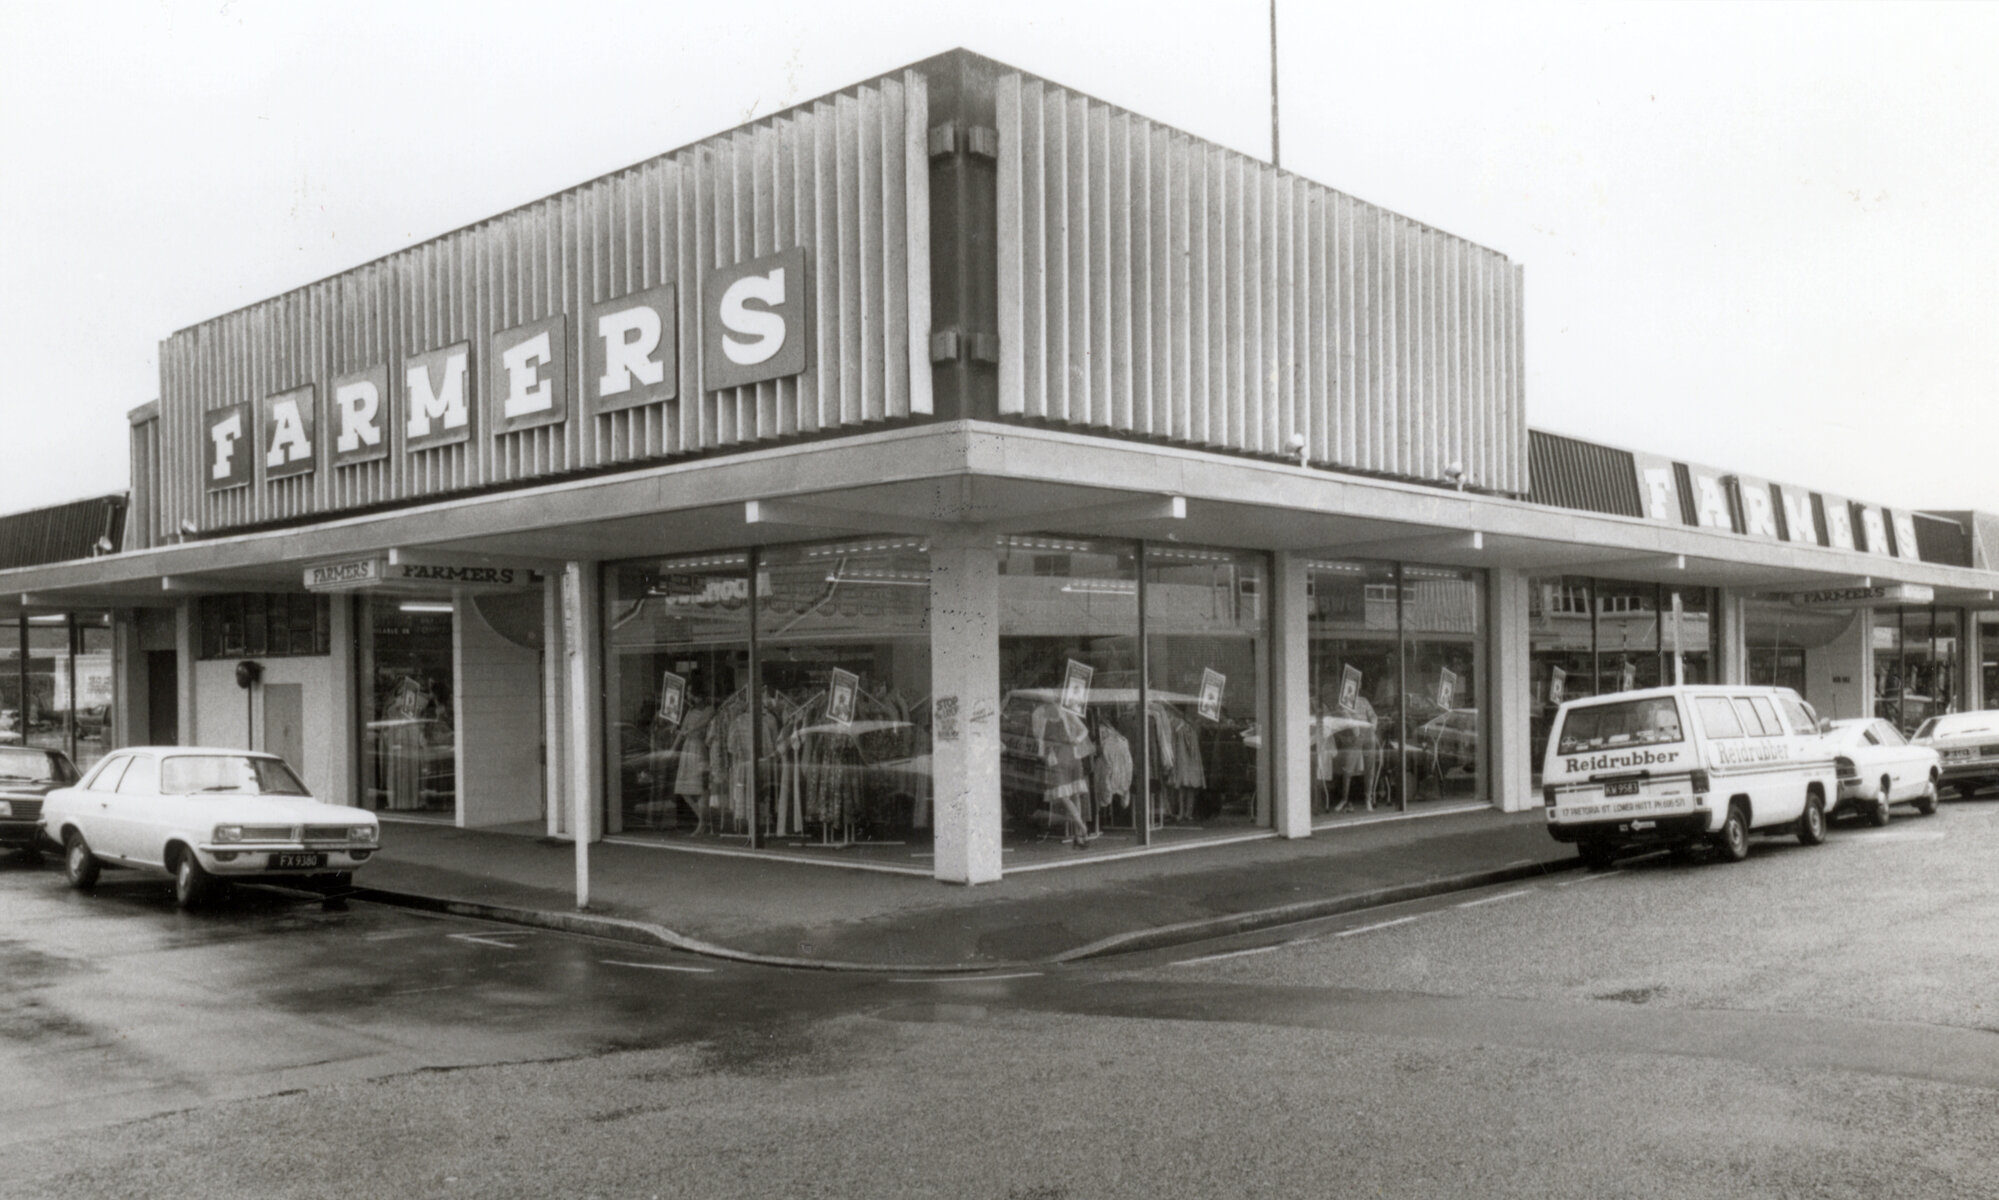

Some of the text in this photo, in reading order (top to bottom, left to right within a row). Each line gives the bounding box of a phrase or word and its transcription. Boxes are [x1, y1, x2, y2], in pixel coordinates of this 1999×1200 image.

[210, 266, 787, 480] FARMERS
[1643, 467, 1919, 561] FARMERS
[312, 562, 369, 583] FARMERS
[402, 564, 514, 584] FARMERS
[1803, 587, 1886, 603] FARMERS
[1565, 750, 1680, 774] Reidrubber
[1715, 740, 1790, 765] Reidrubber
